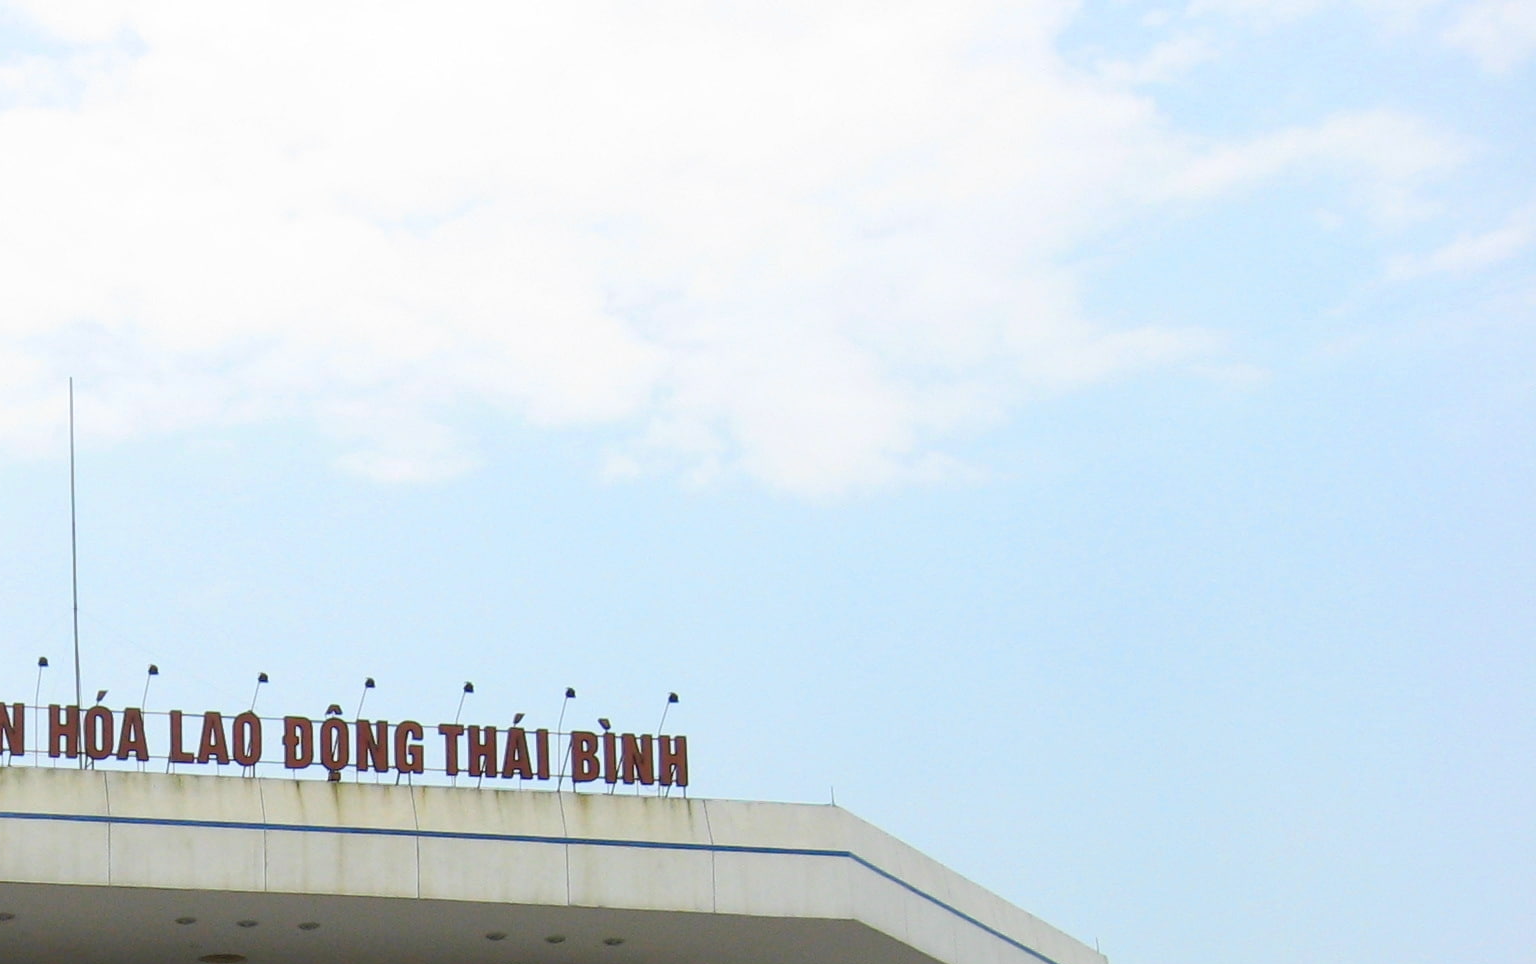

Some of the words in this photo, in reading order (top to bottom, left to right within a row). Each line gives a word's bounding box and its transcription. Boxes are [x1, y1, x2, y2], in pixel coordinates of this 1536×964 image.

[48, 690, 150, 762] HÓA
[170, 710, 263, 767] LAO
[282, 704, 425, 781] ĐỘNG
[439, 713, 551, 780] THÁI
[571, 718, 689, 787] BÌNH
